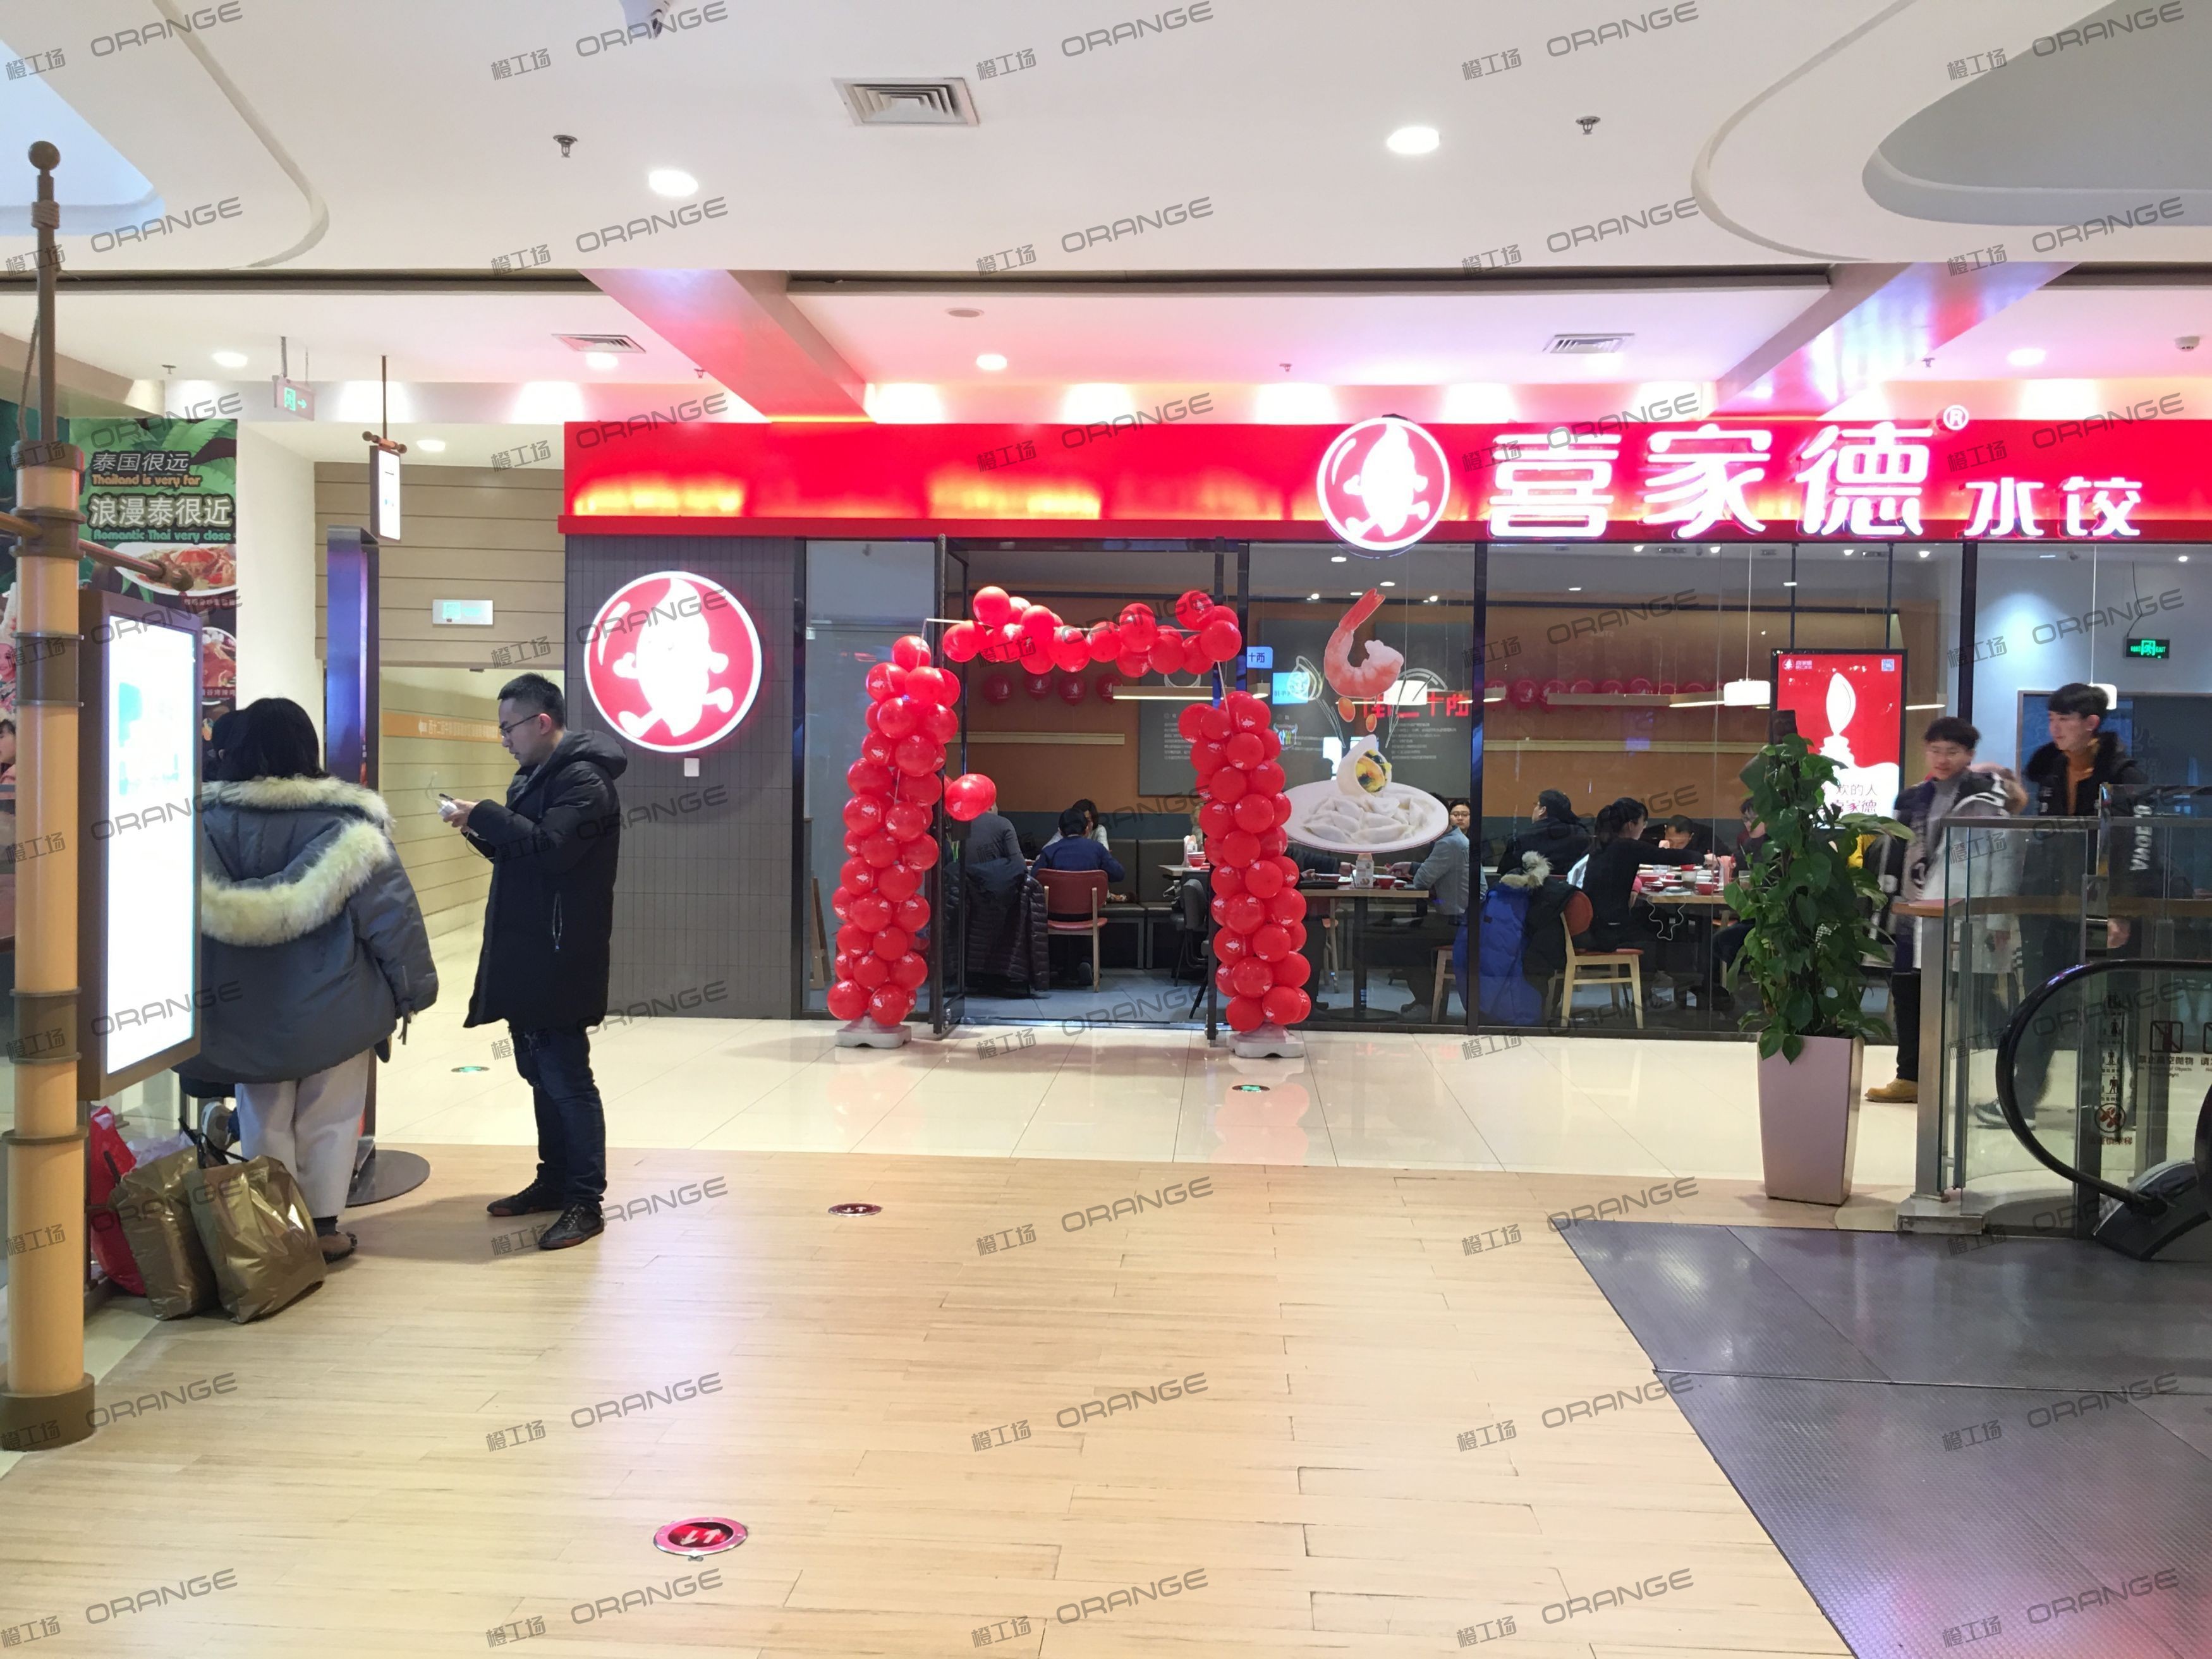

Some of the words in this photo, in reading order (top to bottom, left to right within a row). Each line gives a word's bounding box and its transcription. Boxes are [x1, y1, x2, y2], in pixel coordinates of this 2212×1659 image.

[93, 452, 189, 471] 泰国很远
[92, 474, 139, 485] Thailand
[143, 475, 151, 485] is
[155, 477, 180, 488] very
[183, 475, 201, 485] far
[1488, 422, 1934, 538] 喜家德
[1963, 476, 2142, 537] 水饺
[91, 497, 231, 526] 浪漫泰很近
[94, 529, 145, 540] Romantic
[147, 530, 171, 540] Thai
[174, 532, 199, 544] very
[203, 530, 231, 541] close
